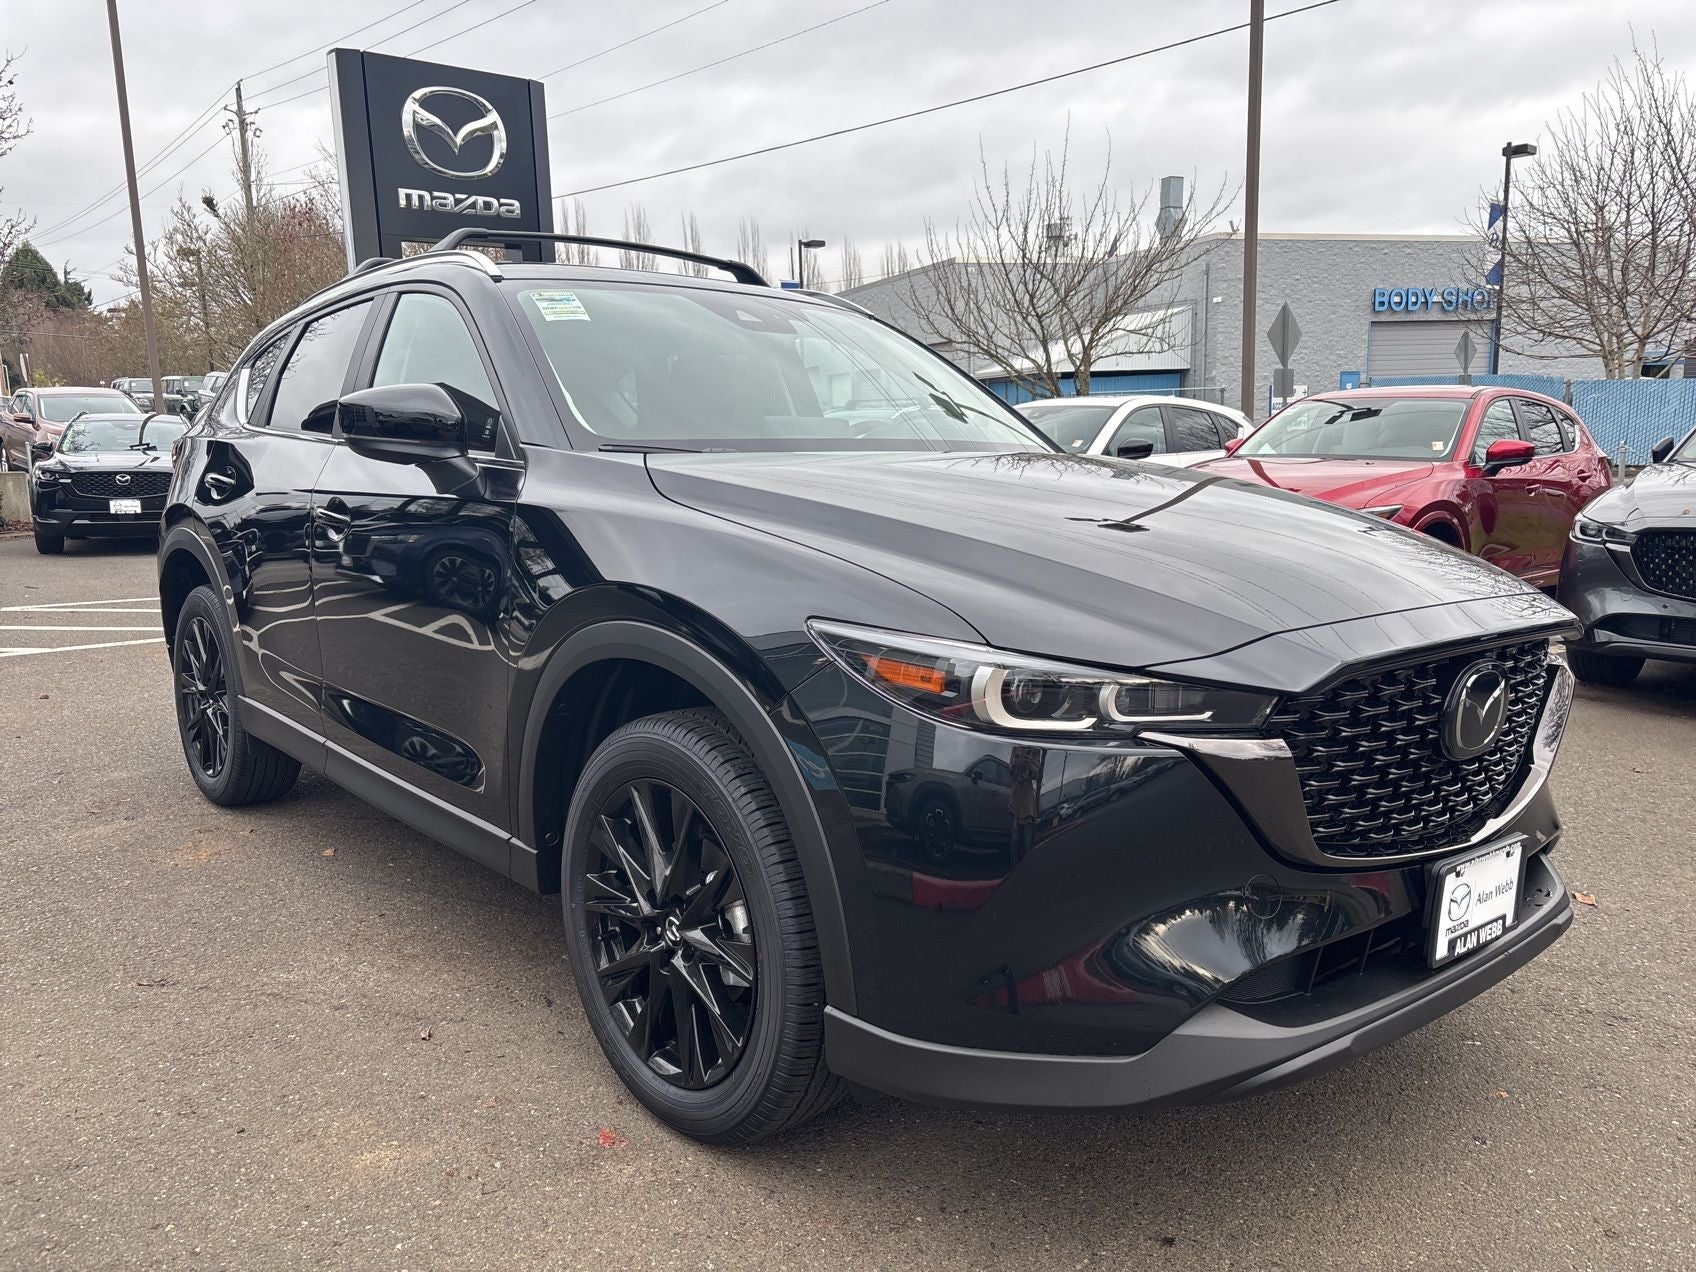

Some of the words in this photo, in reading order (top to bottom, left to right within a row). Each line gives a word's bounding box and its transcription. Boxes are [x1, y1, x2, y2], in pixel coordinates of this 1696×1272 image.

[1374, 287, 1436, 312] BODY
[1475, 890, 1494, 906] Alan
[1495, 878, 1514, 899] Webb
[1455, 930, 1478, 956] ALAN
[1479, 919, 1503, 943] WEBB
